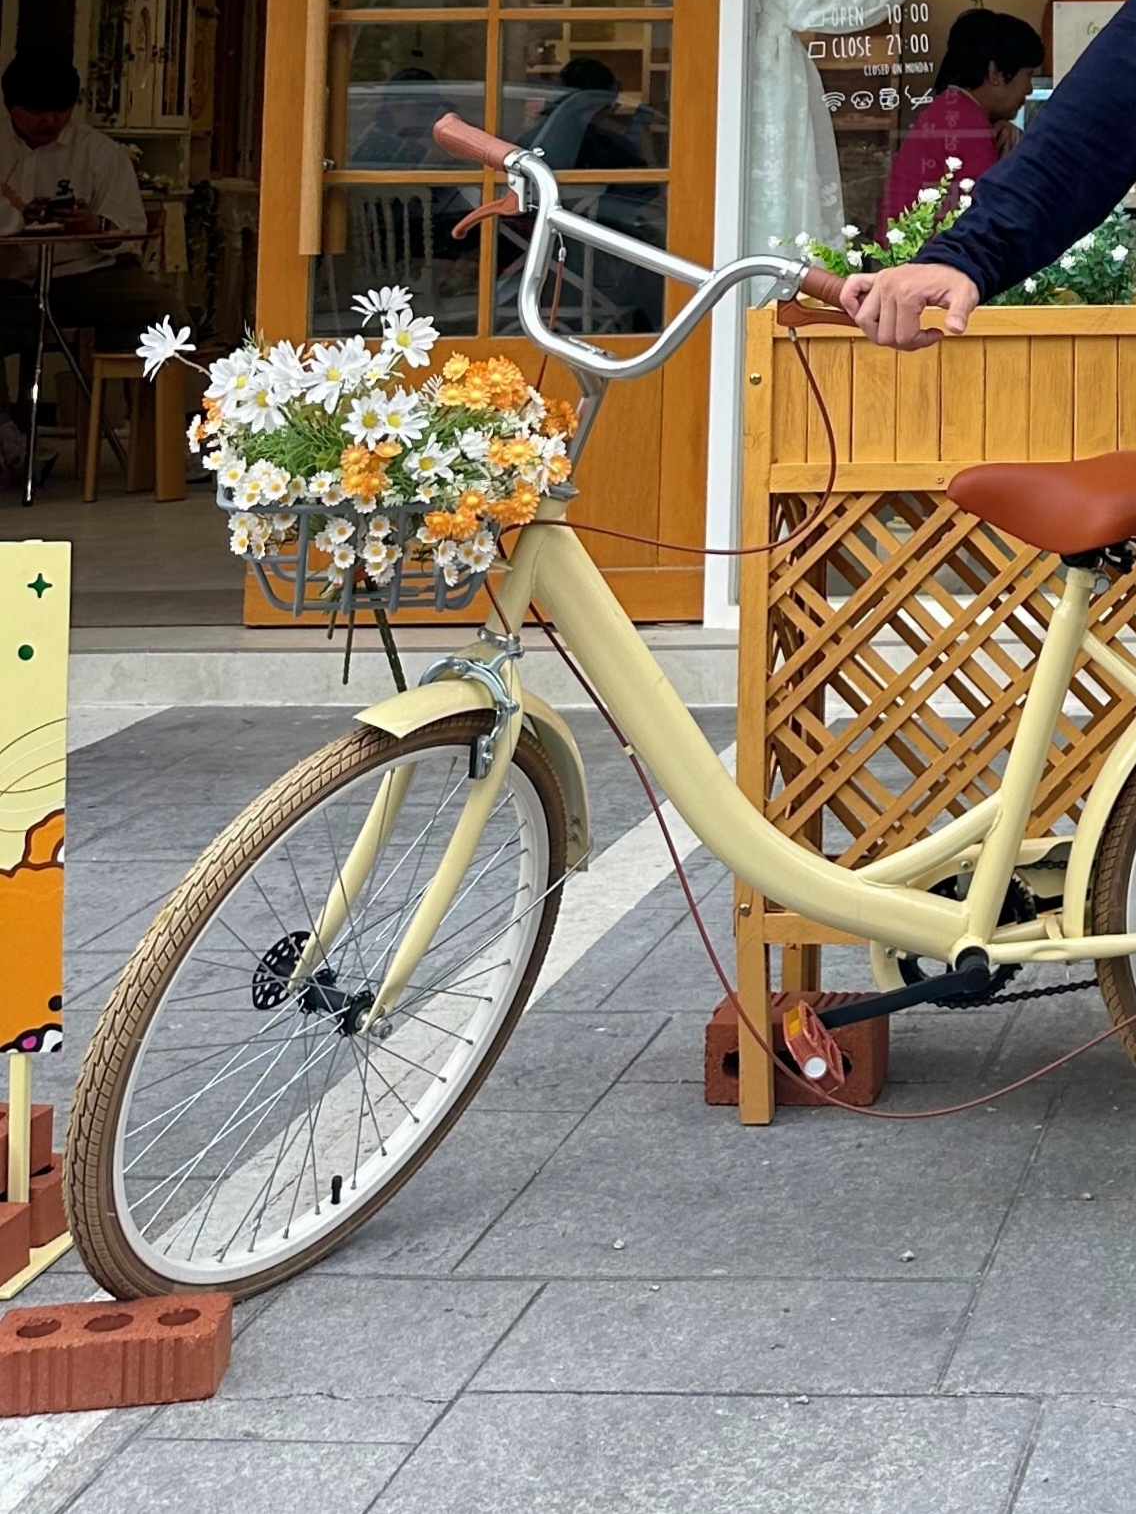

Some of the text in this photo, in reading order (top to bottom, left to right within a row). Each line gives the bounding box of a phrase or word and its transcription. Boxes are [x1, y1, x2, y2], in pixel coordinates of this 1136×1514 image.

[831, 3, 929, 27] OPEN 10:00
[832, 33, 929, 58] CLOSE 21:00
[863, 61, 934, 77] CLOSED ON MONDAY
